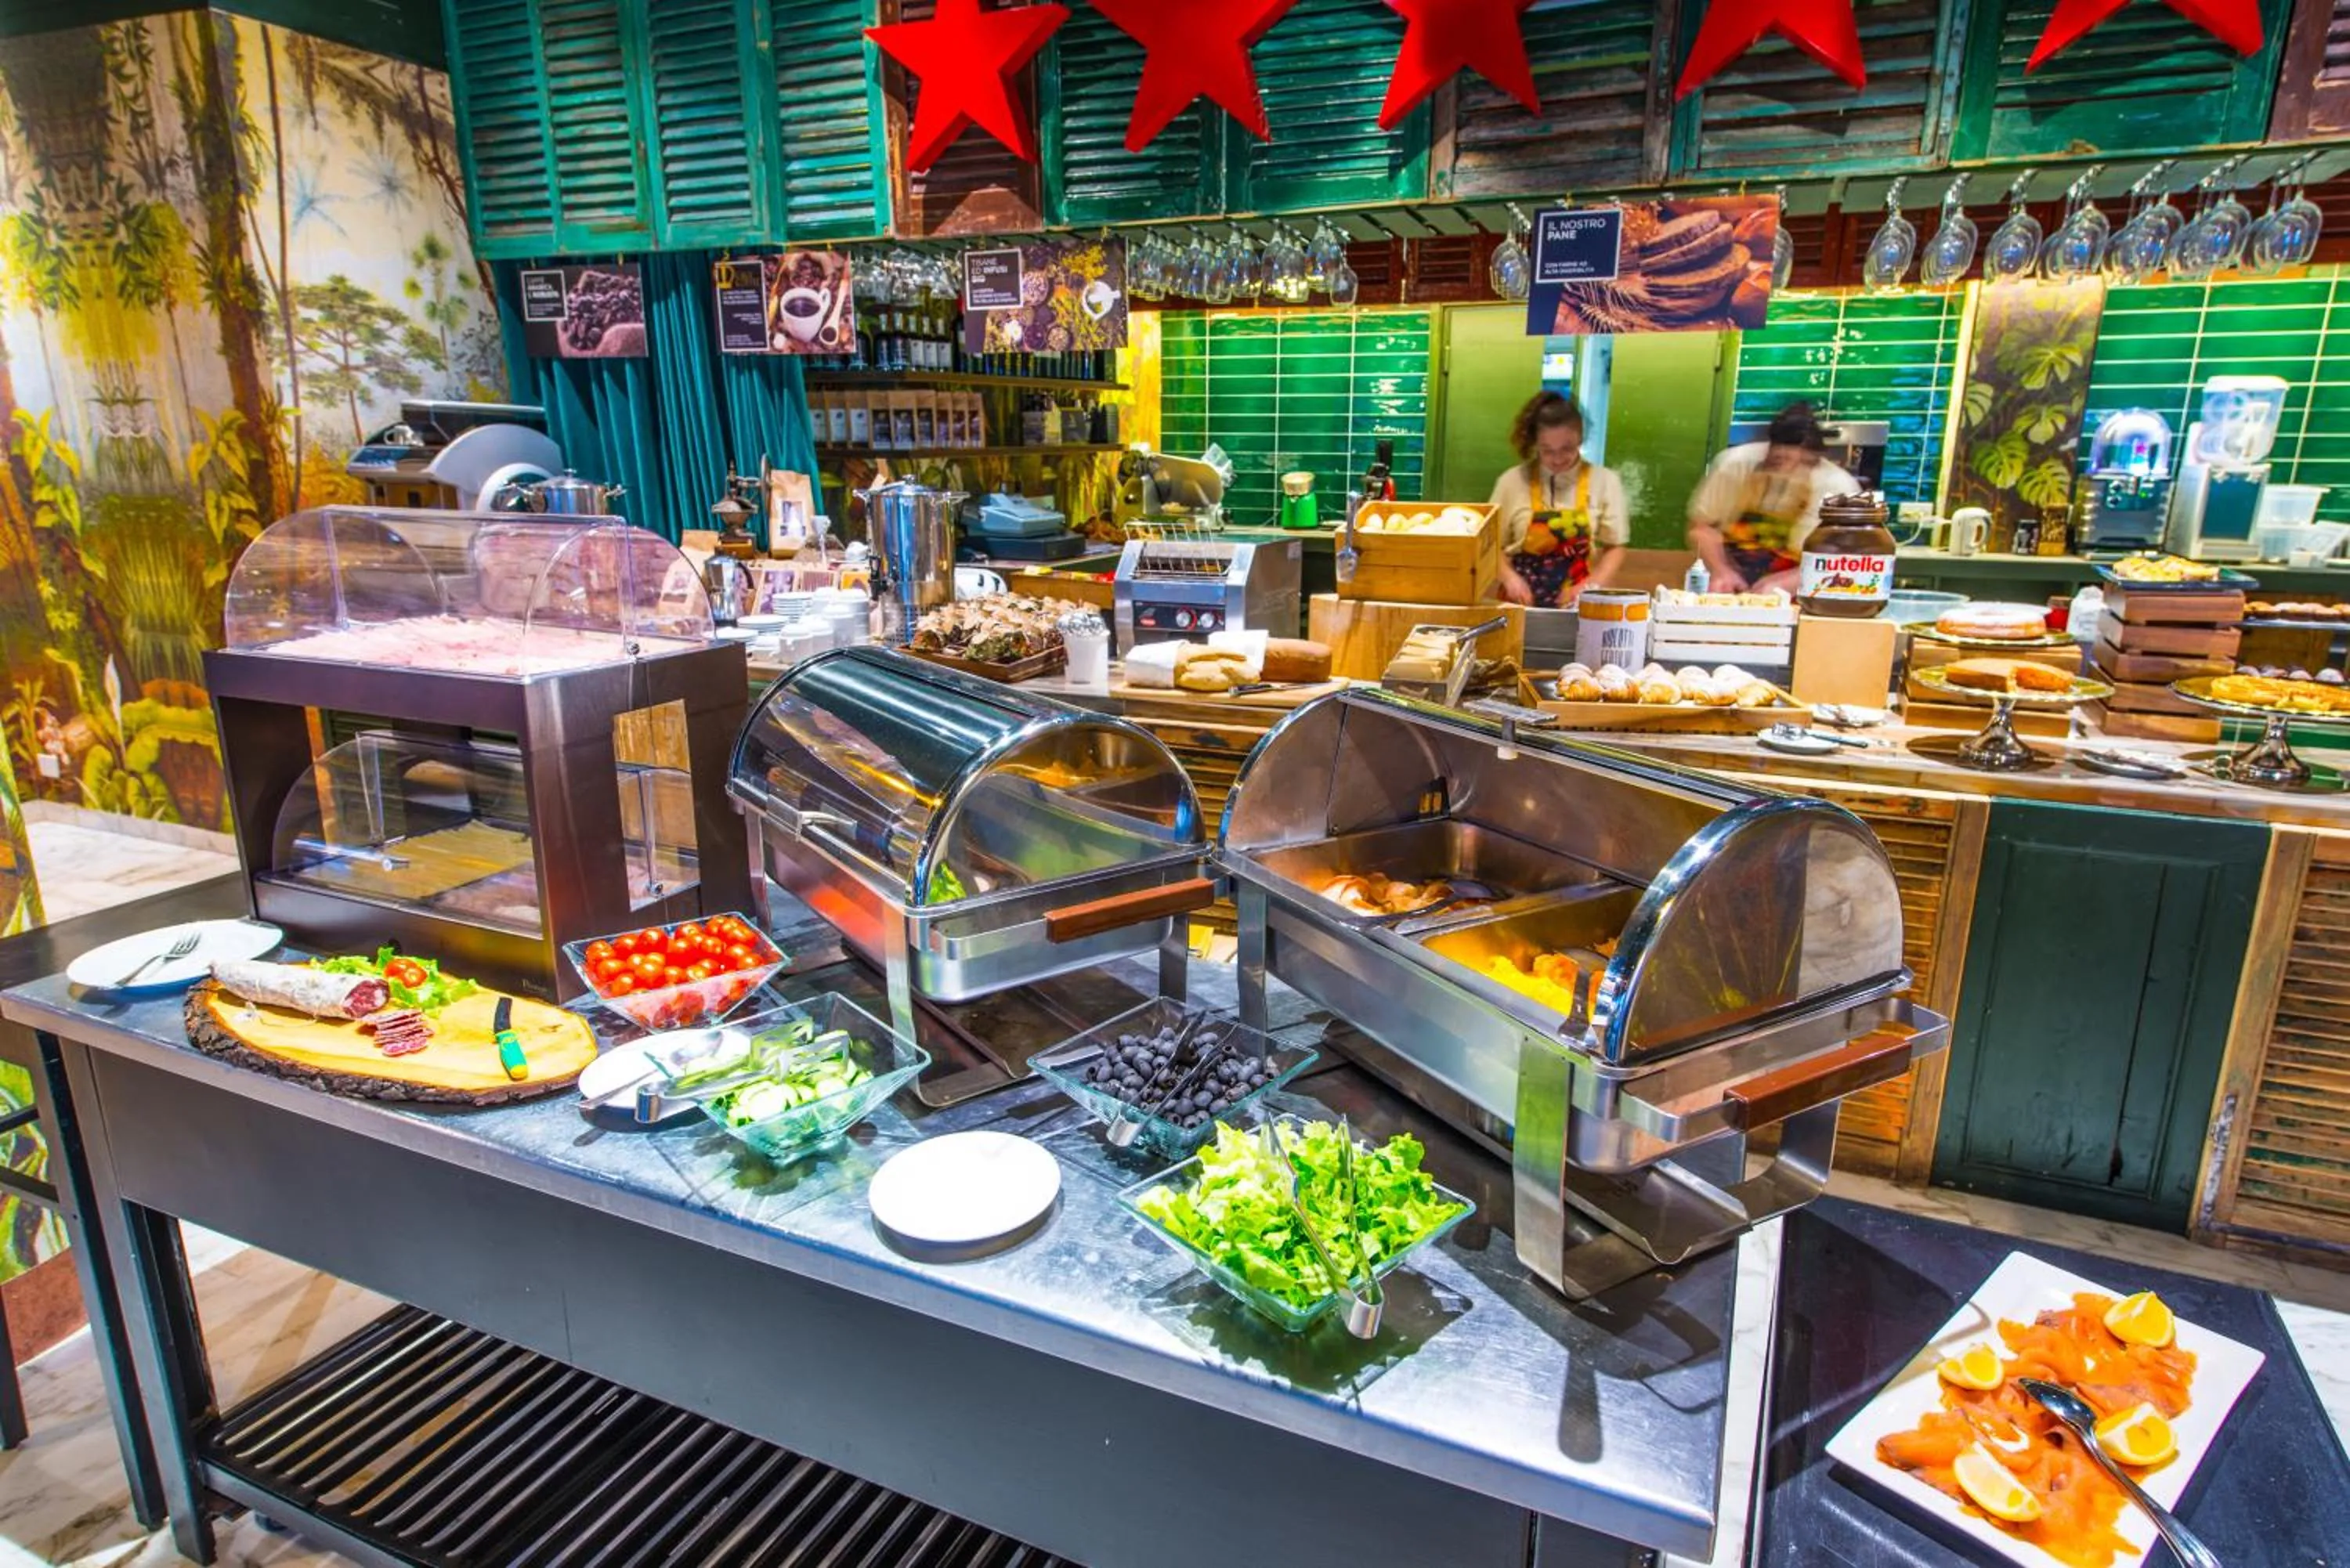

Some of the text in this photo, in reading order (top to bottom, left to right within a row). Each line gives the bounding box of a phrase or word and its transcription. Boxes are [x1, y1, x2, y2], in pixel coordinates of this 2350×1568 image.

[1548, 219, 1607, 230] IL NOSTRO
[1547, 230, 1576, 240] PANE
[1815, 556, 1885, 573] nutella
